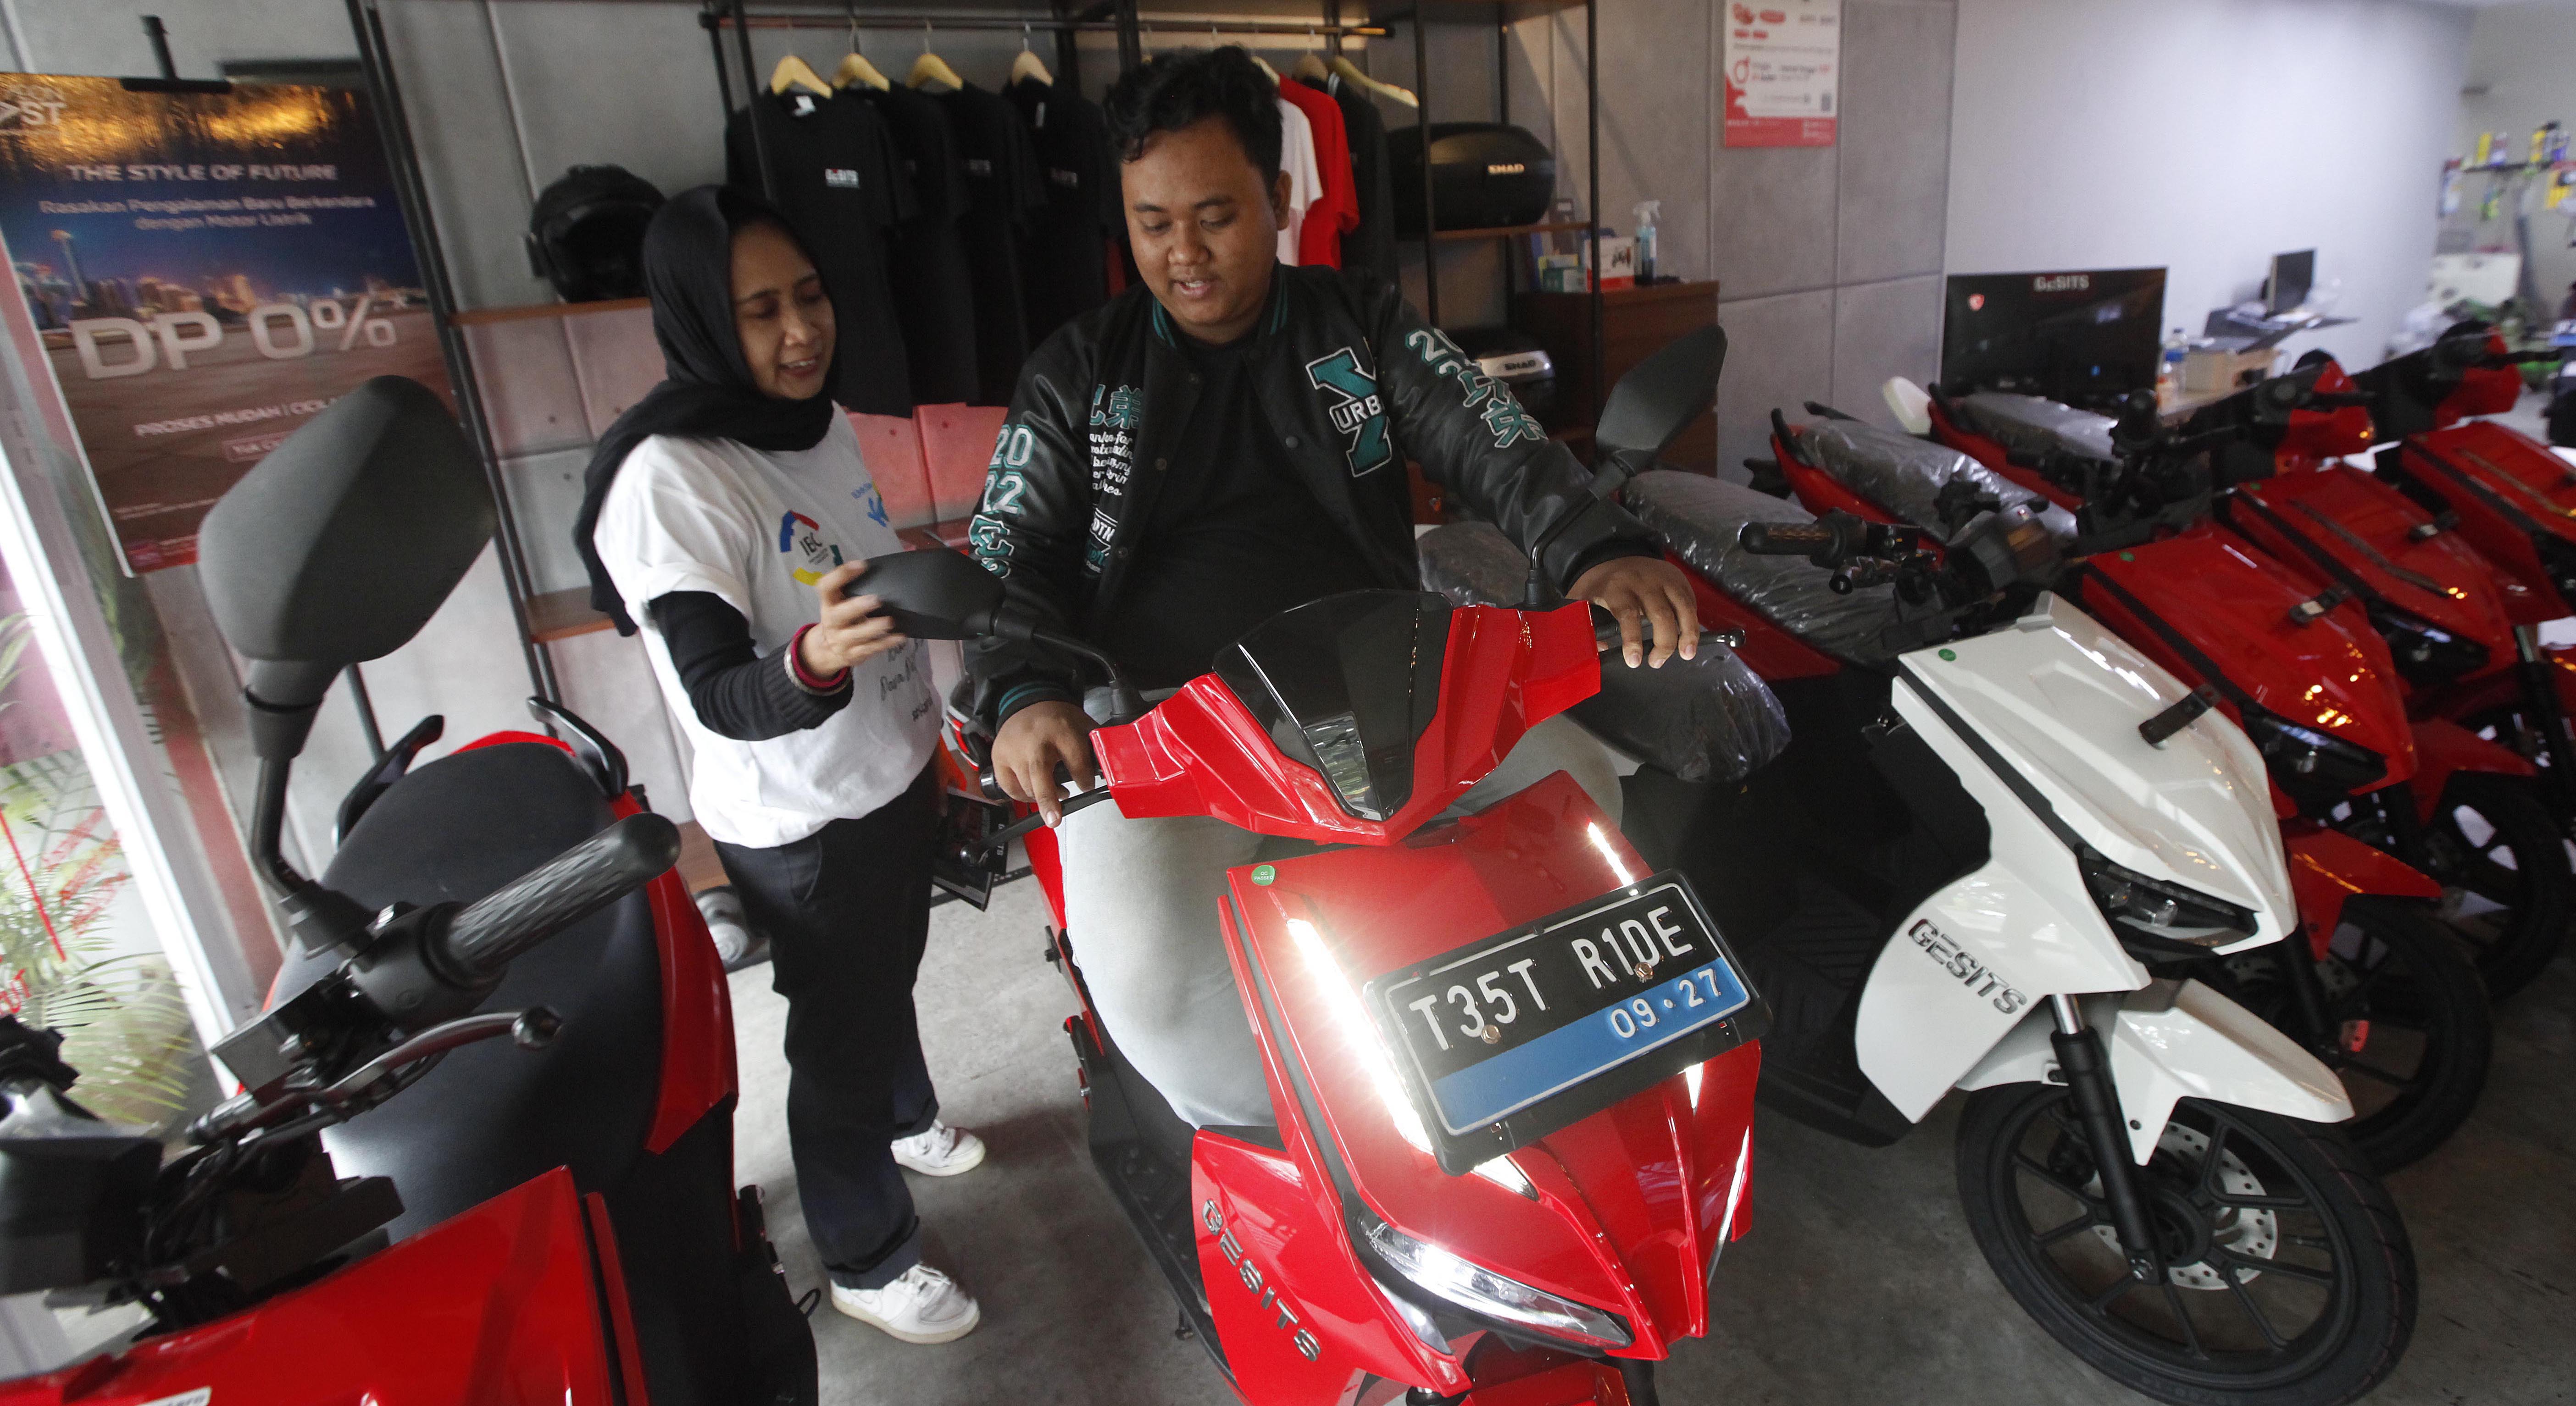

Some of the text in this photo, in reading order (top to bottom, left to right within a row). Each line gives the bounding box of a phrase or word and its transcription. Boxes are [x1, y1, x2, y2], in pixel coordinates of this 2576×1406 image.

[67, 164, 338, 182] THE STYLE OF FUTURE
[69, 311, 223, 379] DP
[988, 423, 1035, 469] 20
[1409, 906, 1694, 1051] T35T R1DE
[1908, 918, 2028, 1015] GESITS
[1201, 1199, 1321, 1362] GESITS
